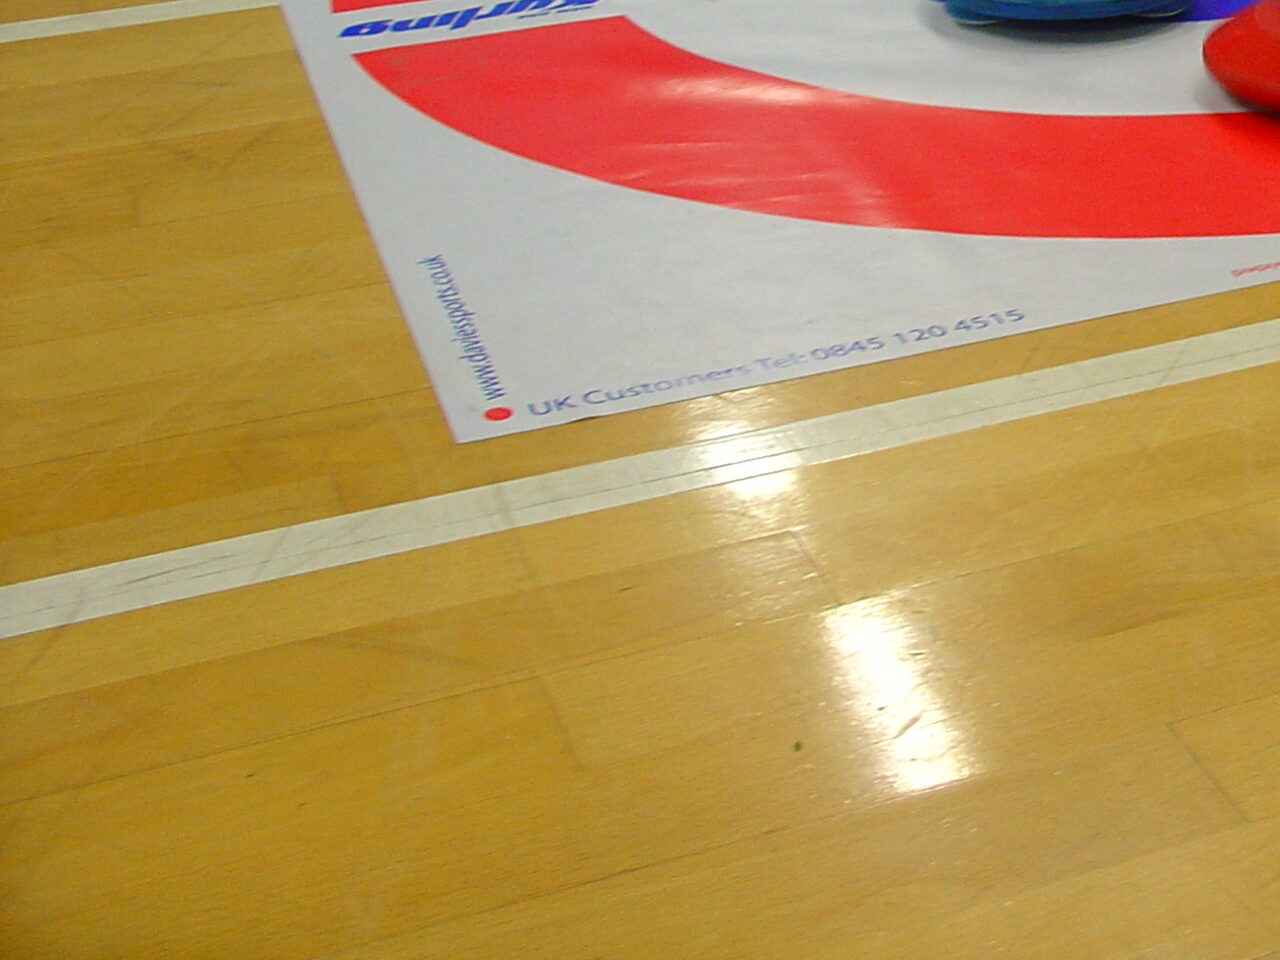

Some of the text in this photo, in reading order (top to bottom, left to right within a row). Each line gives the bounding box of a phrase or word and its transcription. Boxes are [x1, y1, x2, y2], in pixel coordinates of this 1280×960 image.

[527, 395, 577, 416] UK
[581, 364, 752, 405] Customers
[892, 324, 947, 344] 120
[953, 308, 1025, 333] 4515
